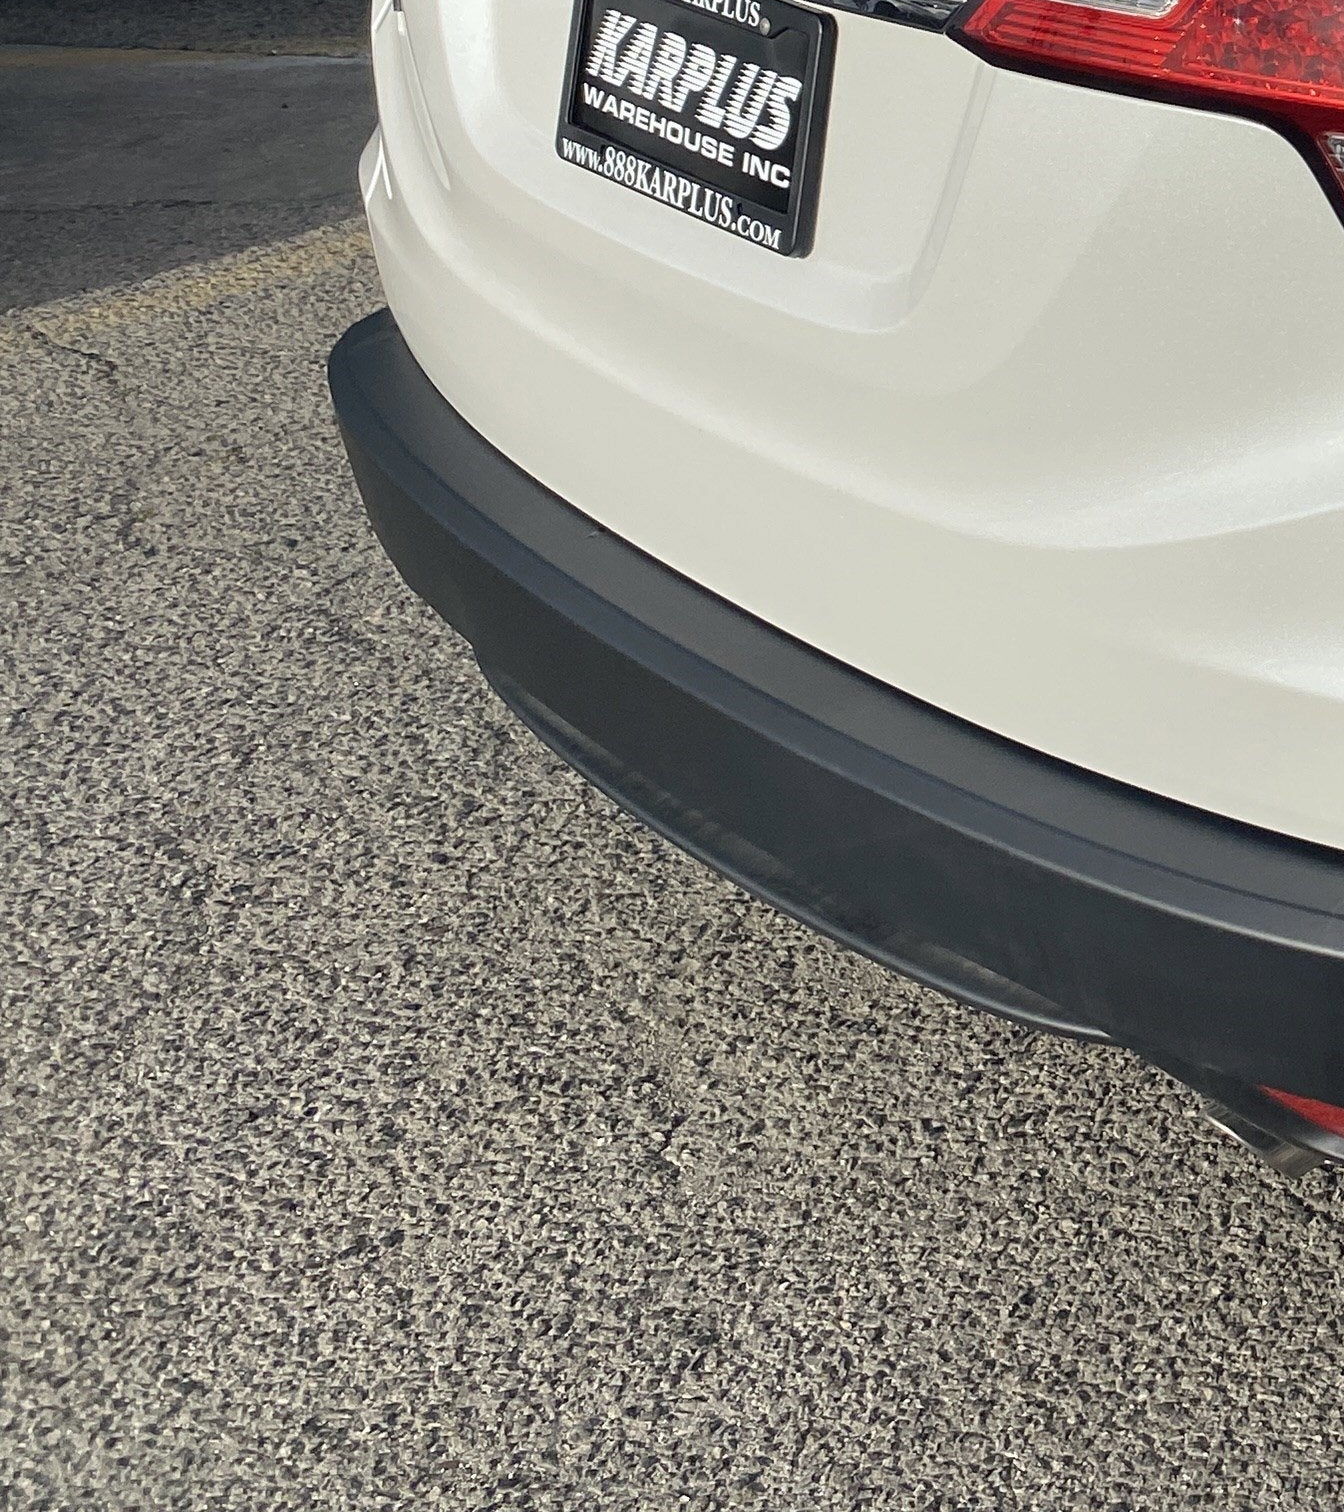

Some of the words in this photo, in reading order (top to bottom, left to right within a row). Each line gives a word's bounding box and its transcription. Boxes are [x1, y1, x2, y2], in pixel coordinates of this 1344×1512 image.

[583, 82, 734, 168] WAREHOUSE
[743, 151, 791, 188] INC
[585, 9, 803, 151] KARPLUS
